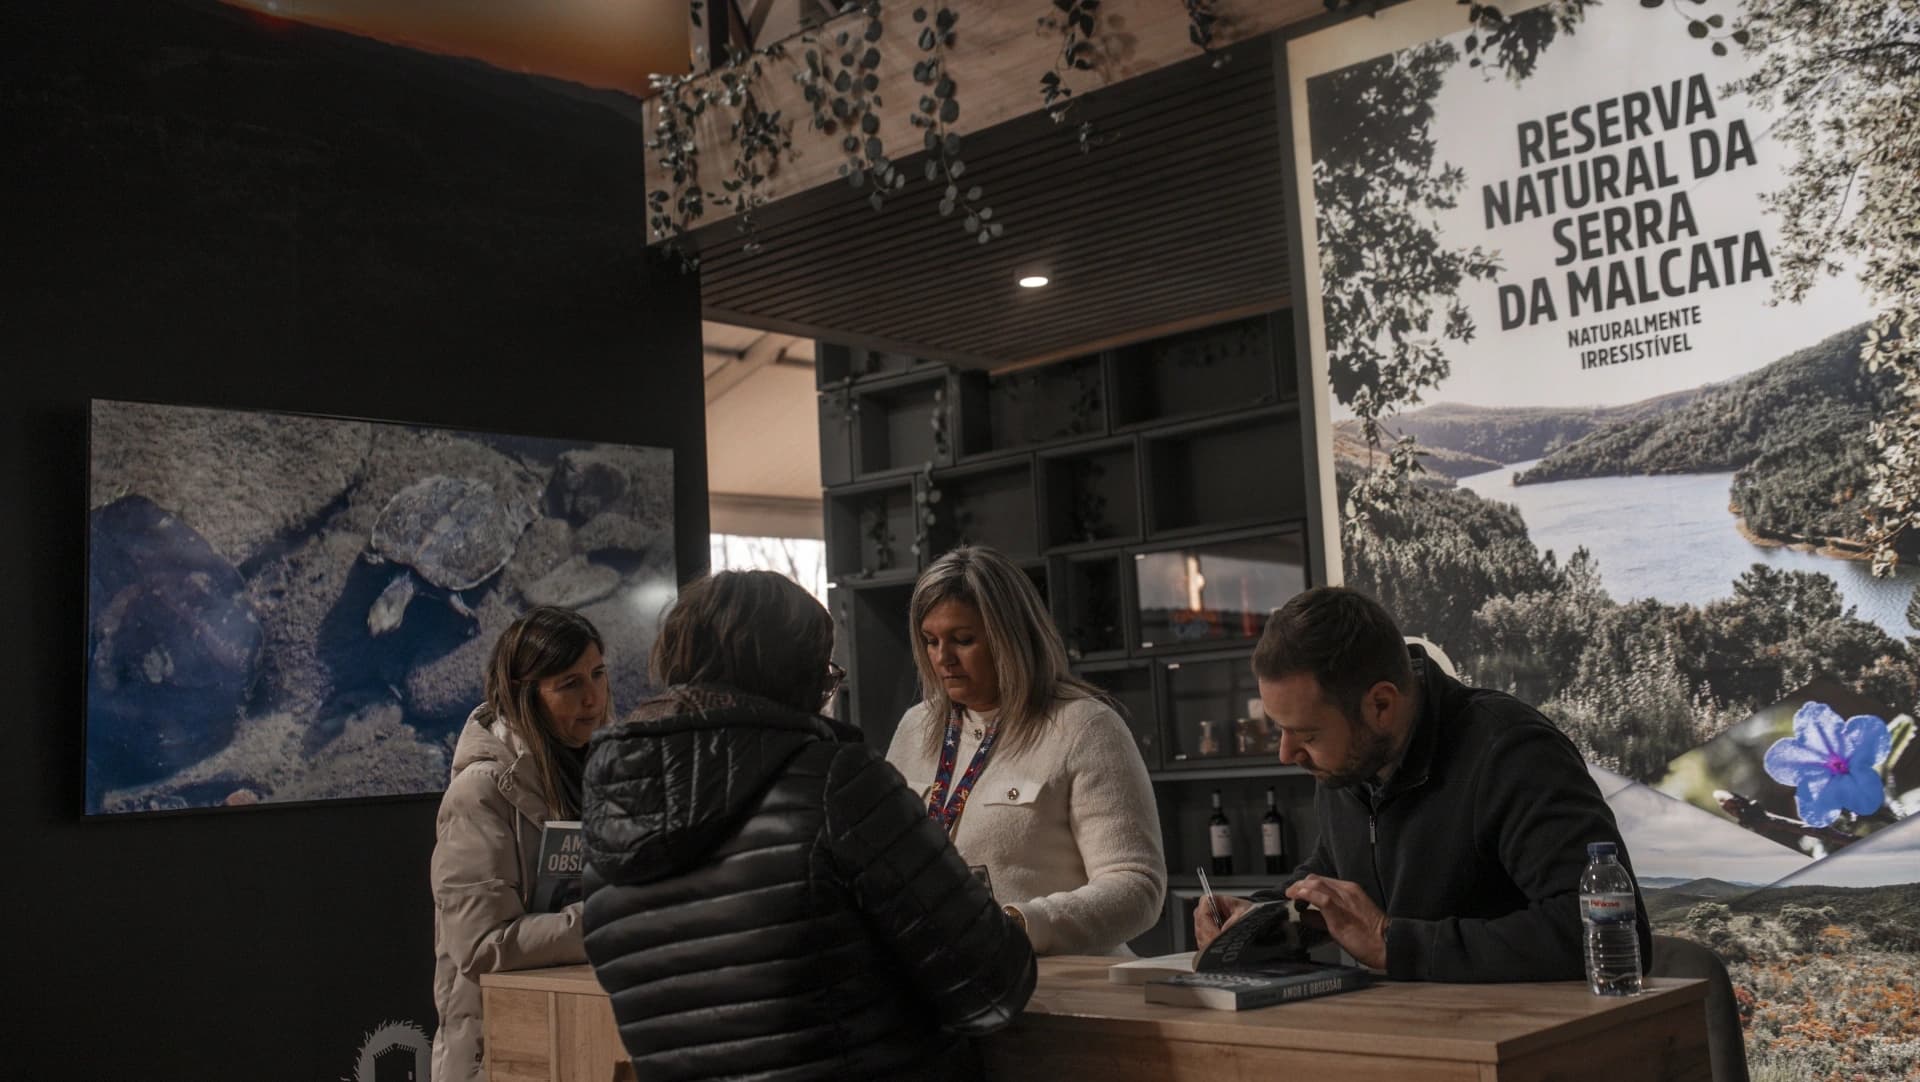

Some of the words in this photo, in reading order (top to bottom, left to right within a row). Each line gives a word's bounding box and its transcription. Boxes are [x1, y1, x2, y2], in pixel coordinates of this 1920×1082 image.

[1517, 73, 1716, 168] RESERVA
[1483, 140, 1679, 229] NATURAL
[1690, 118, 1758, 180] DA
[1553, 190, 1699, 266] SERRA
[1498, 277, 1558, 331] DA
[1567, 230, 1774, 317] MALCATA
[1568, 305, 1702, 348] NATURALMENTE
[1581, 332, 1693, 370] IRRESISTÍVEL
